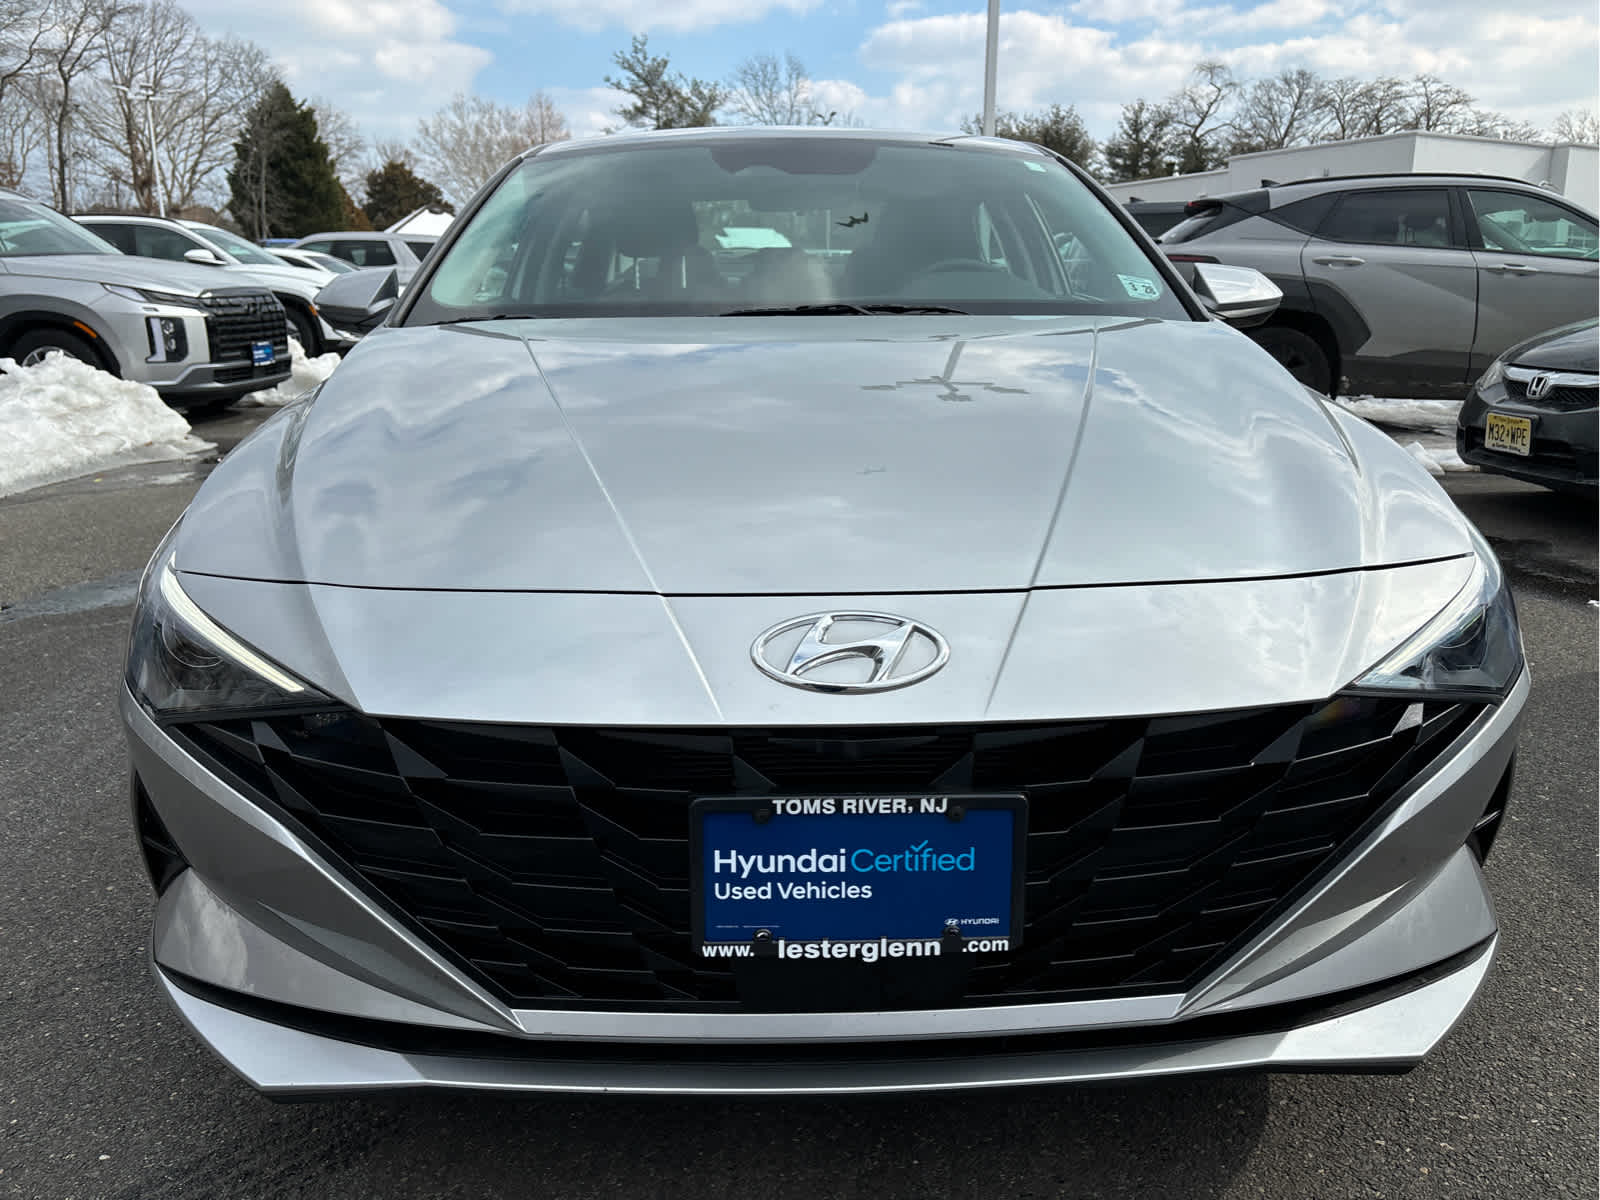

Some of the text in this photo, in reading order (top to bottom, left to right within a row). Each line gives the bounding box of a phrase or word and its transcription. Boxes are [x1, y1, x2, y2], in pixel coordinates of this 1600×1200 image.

[772, 798, 947, 814] TOMS RIVER, NJ
[715, 840, 974, 878] Hyundai Certified
[715, 881, 872, 899] Used Vehicles
[703, 939, 1008, 962] www. lesterglenn .com
